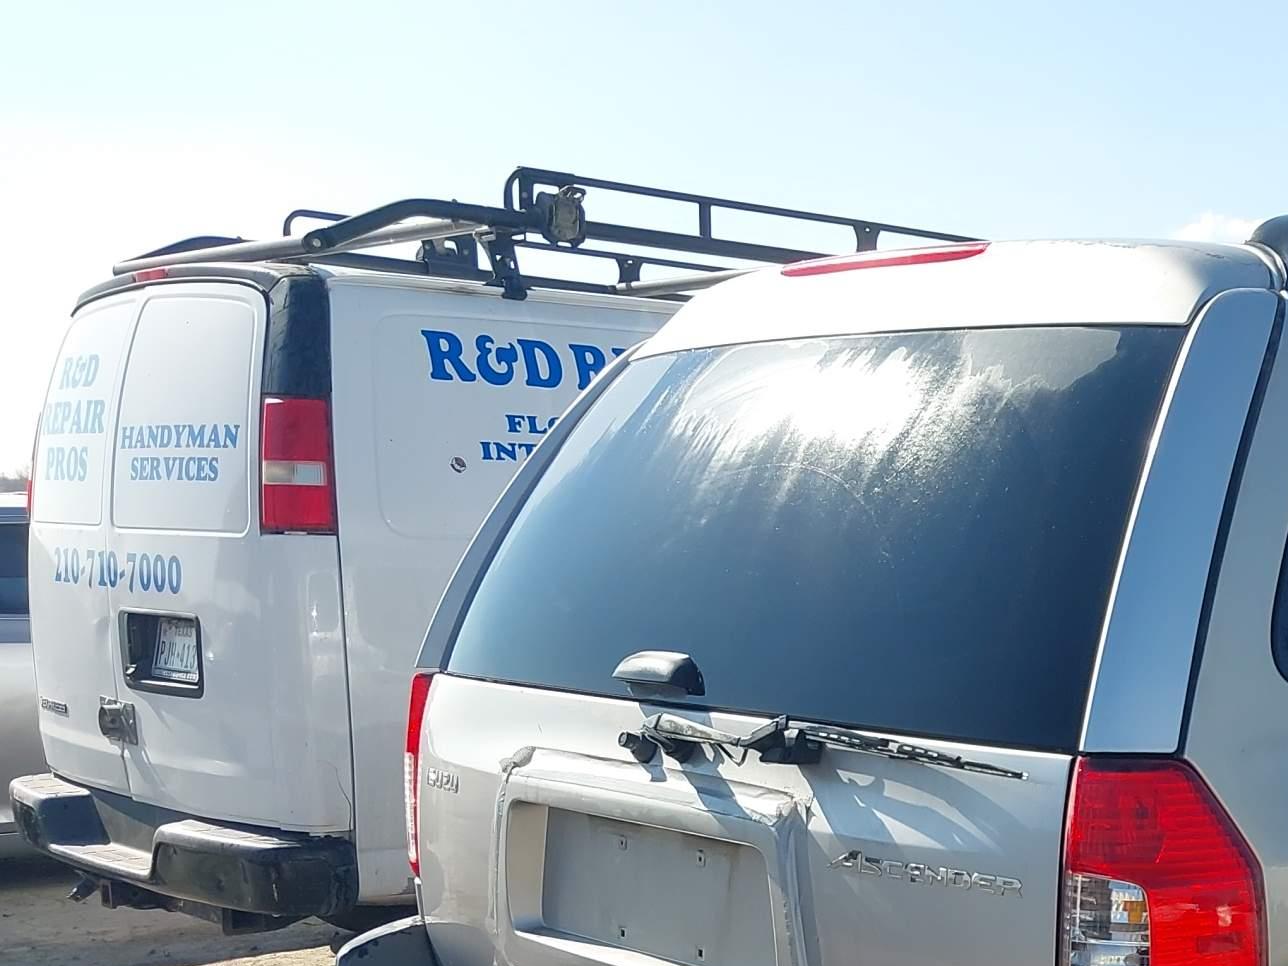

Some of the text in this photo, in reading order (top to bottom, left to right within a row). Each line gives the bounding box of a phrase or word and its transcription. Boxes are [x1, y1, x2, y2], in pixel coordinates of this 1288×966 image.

[58, 354, 100, 390] R&D
[421, 329, 627, 391] R&D R
[43, 399, 106, 435] REPAIR
[120, 423, 241, 450] HANDYMAN
[45, 446, 88, 482] PROS
[130, 456, 219, 482] SERVICES
[54, 547, 182, 594] 210-710-7000
[826, 850, 1023, 898] ASCENDER
